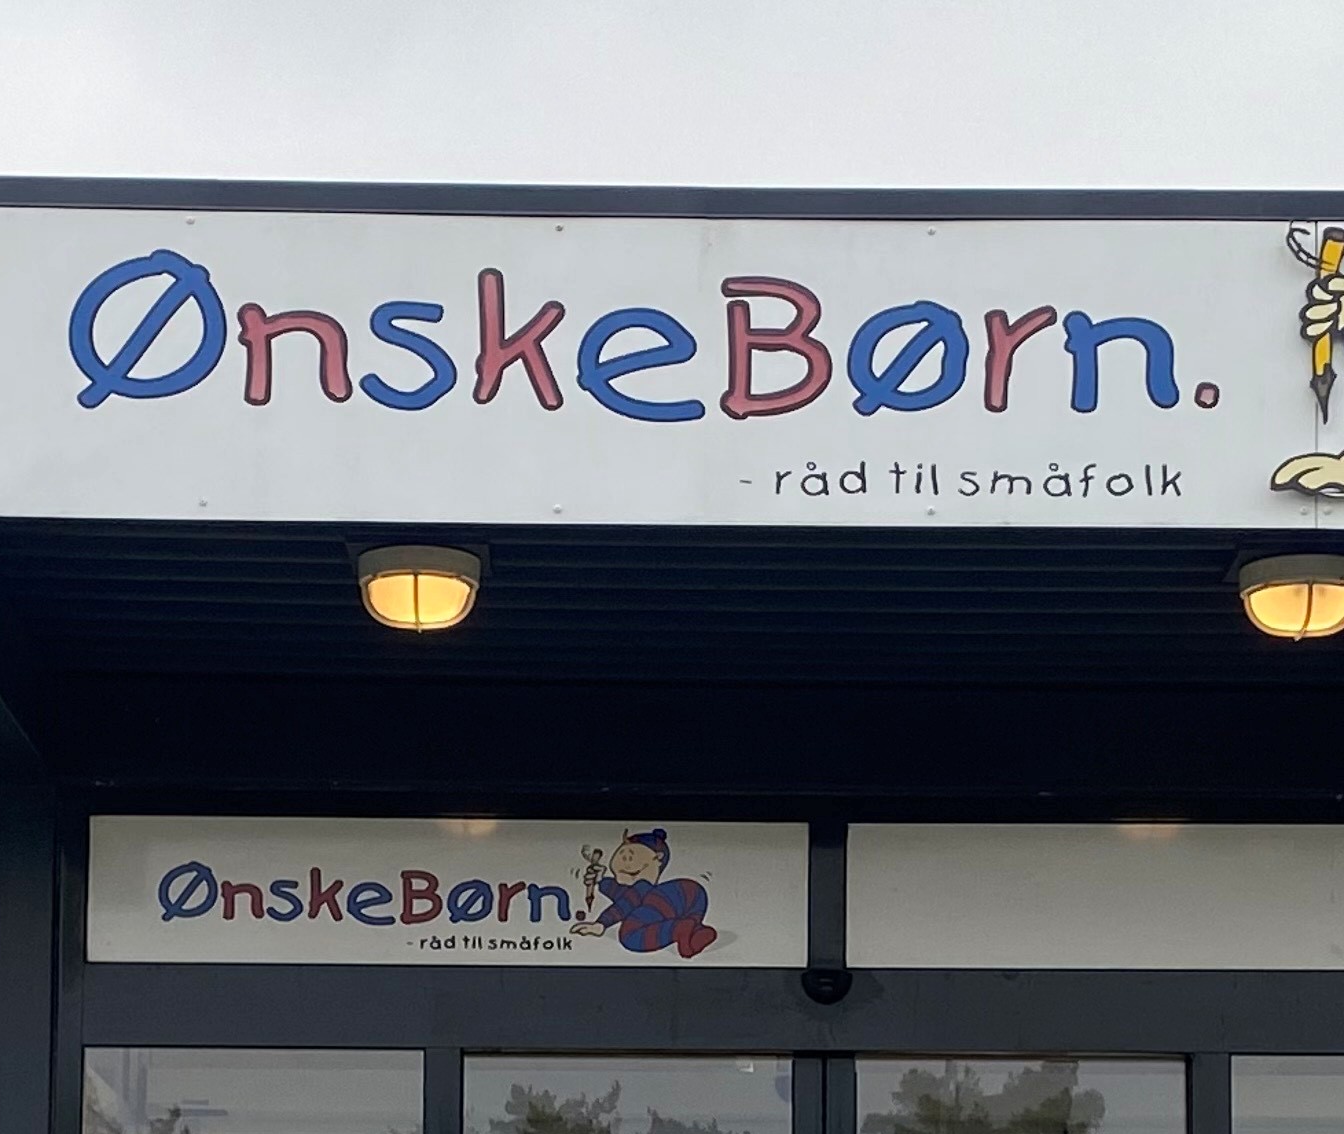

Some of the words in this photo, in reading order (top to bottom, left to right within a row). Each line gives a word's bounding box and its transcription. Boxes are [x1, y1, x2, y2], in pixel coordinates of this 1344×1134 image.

[774, 461, 867, 497] råd
[890, 462, 940, 497] til
[958, 461, 1184, 497] småfolk
[419, 935, 456, 951] råd
[461, 935, 484, 950] til
[486, 935, 574, 951] småfolk
